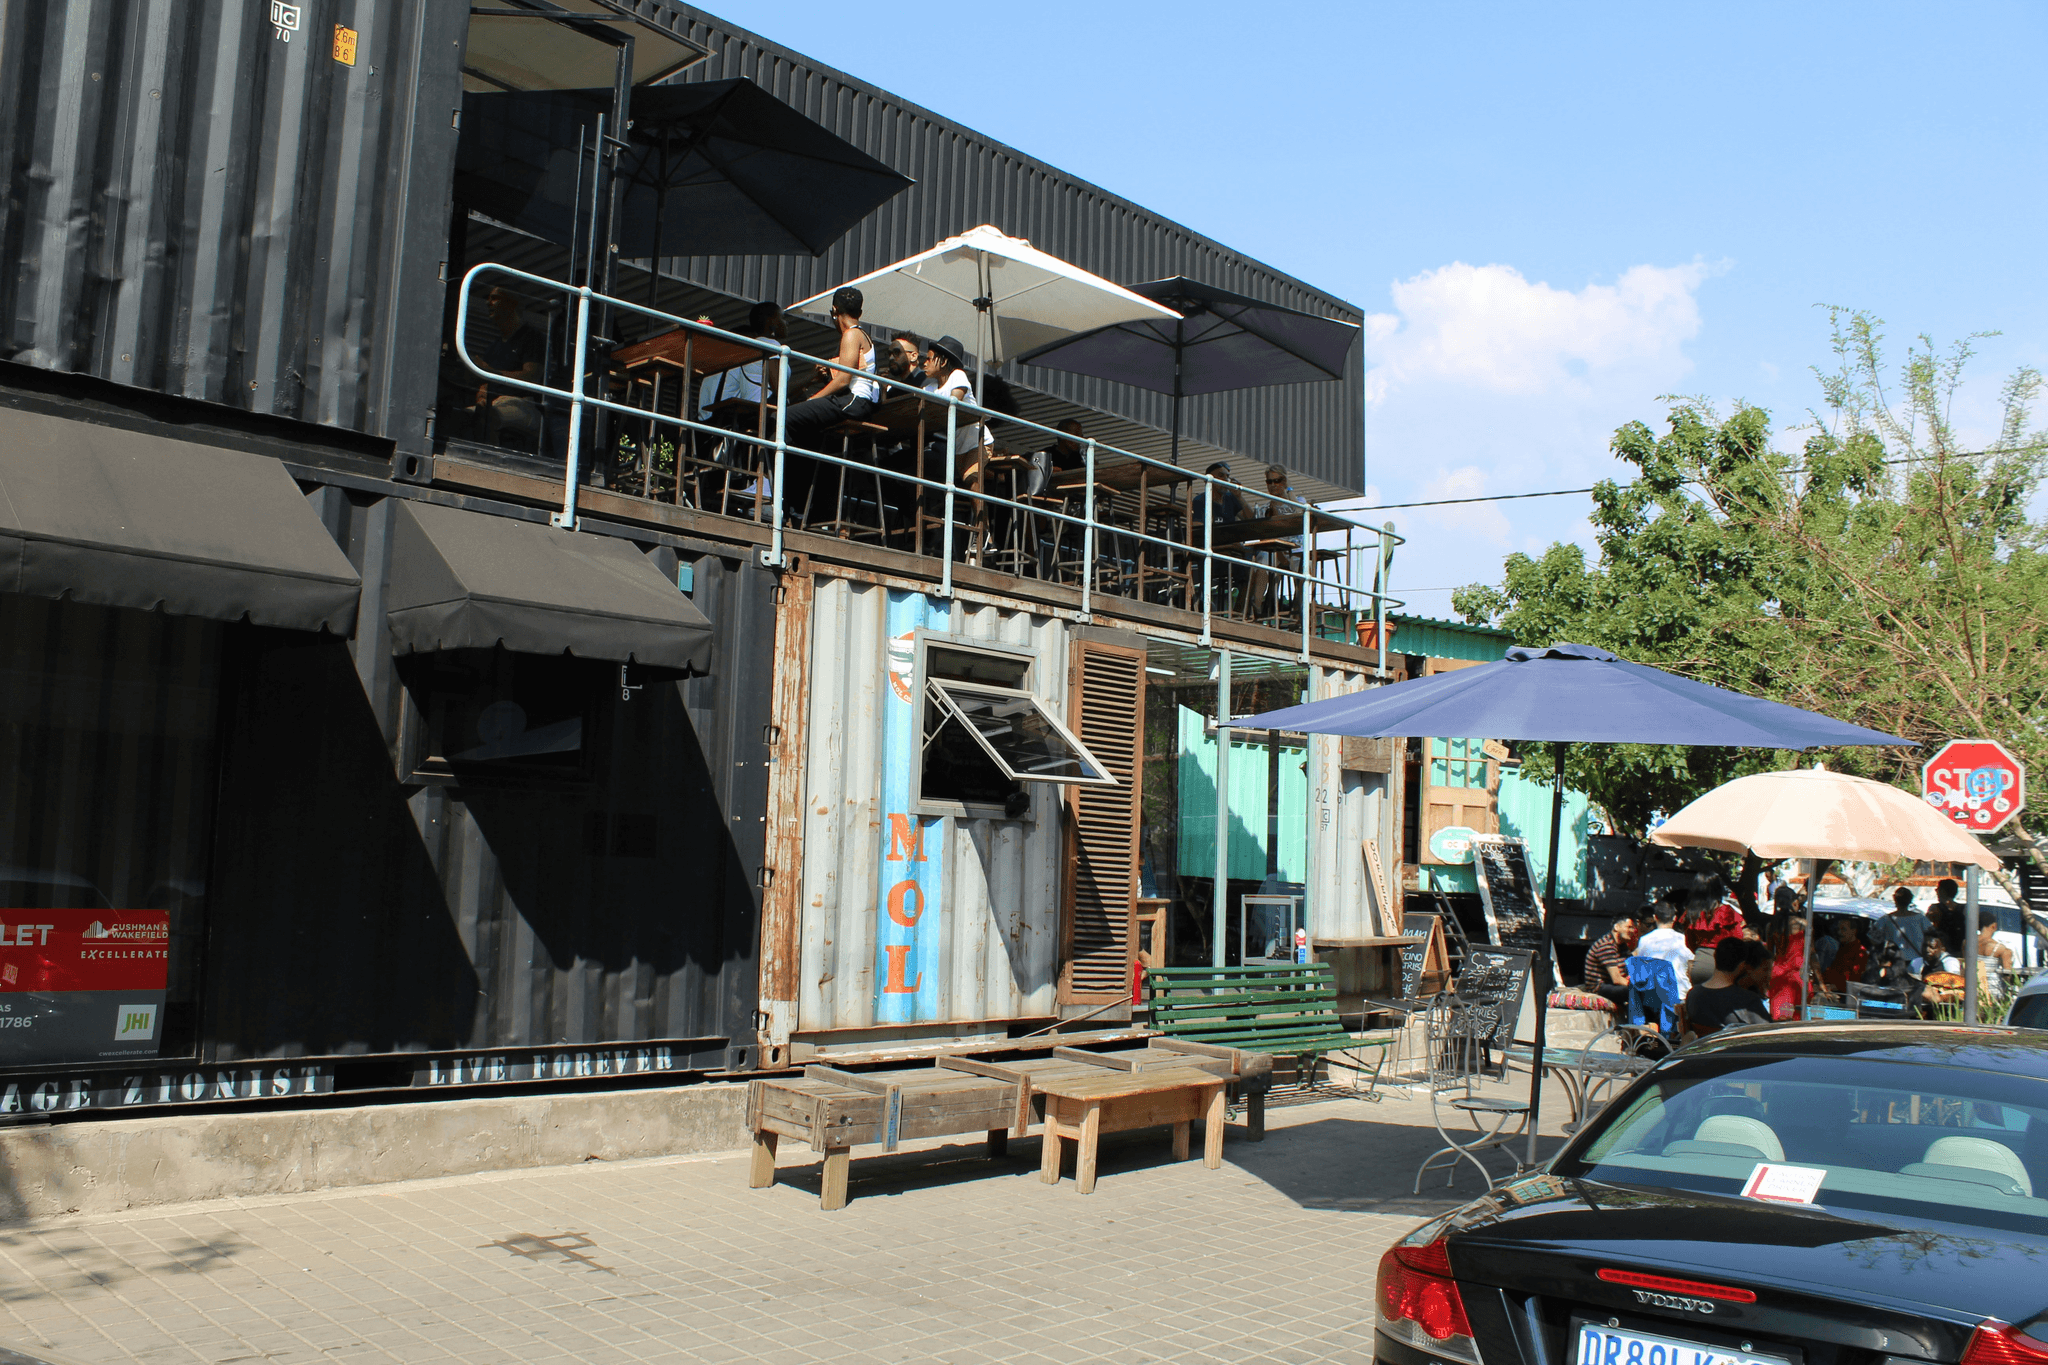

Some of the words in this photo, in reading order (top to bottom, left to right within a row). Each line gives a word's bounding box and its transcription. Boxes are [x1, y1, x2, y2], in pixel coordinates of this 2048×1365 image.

[275, 26, 290, 43] 70
[1933, 768, 2014, 801] STOP
[883, 813, 928, 993] MOL
[0, 924, 54, 946] LET
[112, 923, 160, 931] CUSHMAN
[112, 931, 169, 939] WAKEFIELD
[80, 949, 168, 960] EXCELLERATE
[121, 1012, 150, 1034] JHI
[99, 1049, 158, 1057] cwexcellerate.com
[428, 1056, 506, 1086] LIVE
[532, 1046, 673, 1080] FOREVER
[123, 1066, 321, 1105] ZIONIST
[1632, 1289, 1715, 1314] VOLVO
